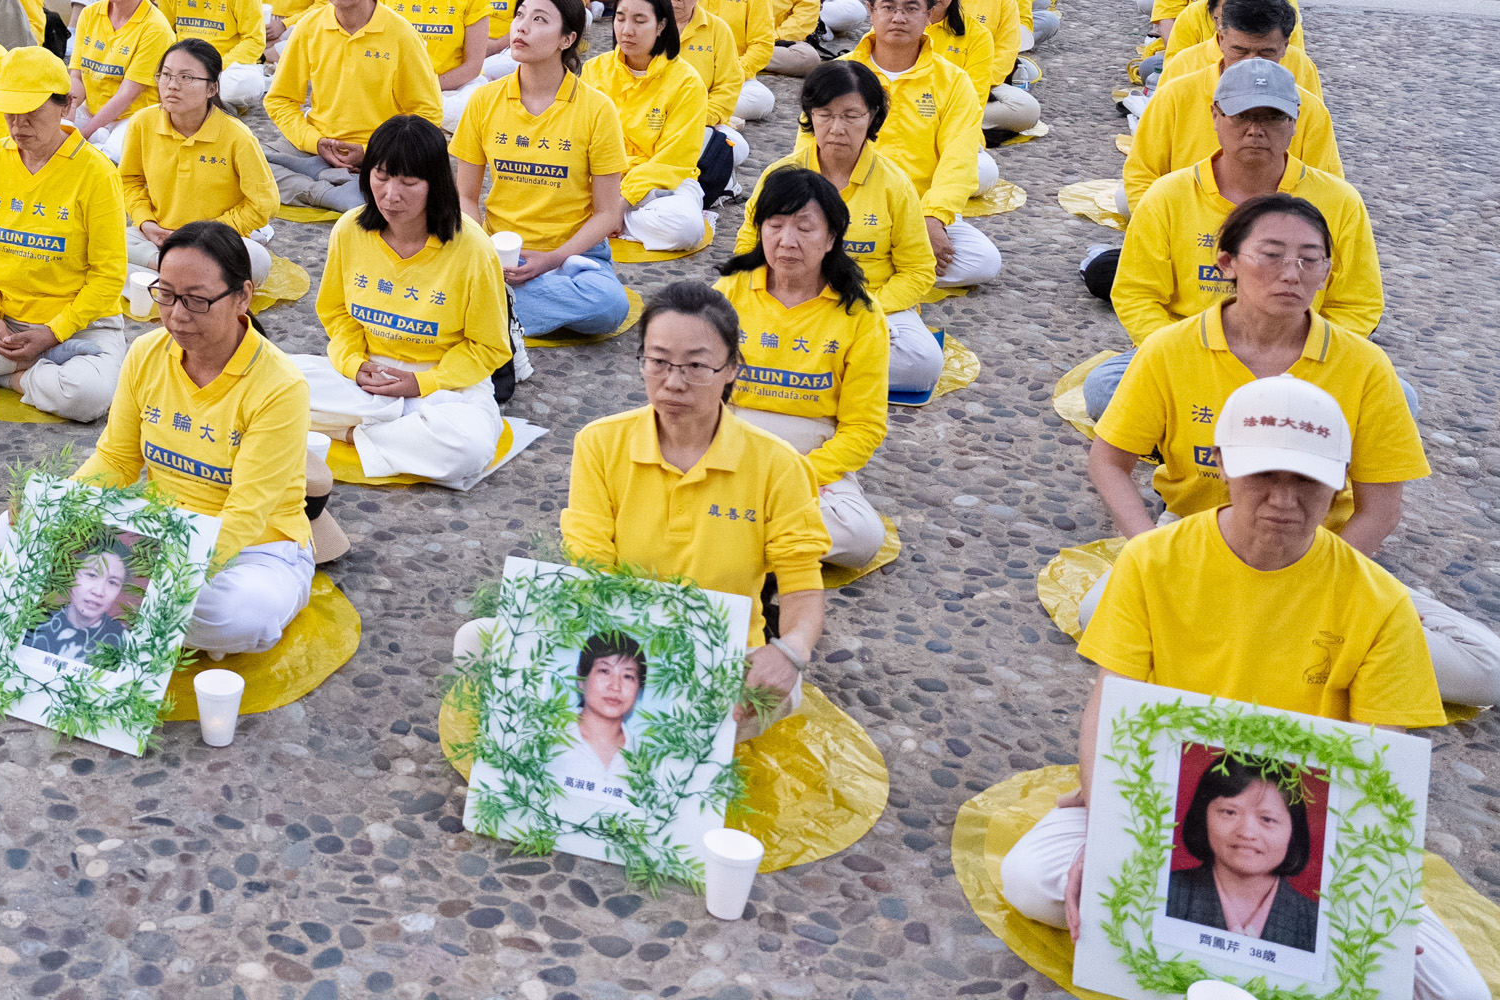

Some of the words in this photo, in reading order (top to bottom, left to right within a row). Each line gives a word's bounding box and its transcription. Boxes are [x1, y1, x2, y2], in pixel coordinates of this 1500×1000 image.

[426, 25, 450, 34] DAFA
[495, 132, 572, 152] 法輪大法
[496, 160, 531, 174] FALUN
[534, 166, 565, 177] DAFA
[498, 174, 562, 188] www.falundafa.org
[28, 235, 62, 250] DAFA
[354, 273, 446, 306] 法輪大法
[354, 306, 394, 326] FALUN
[396, 319, 433, 334] DAFA
[789, 374, 830, 388] DAFA
[144, 404, 242, 446] 法輪大法
[1243, 415, 1331, 438] 法輪大法好
[146, 446, 195, 473] FALUN
[602, 786, 622, 798] 49歲
[1199, 933, 1240, 953] 齊鳳芹
[1249, 947, 1276, 963] 38歲
